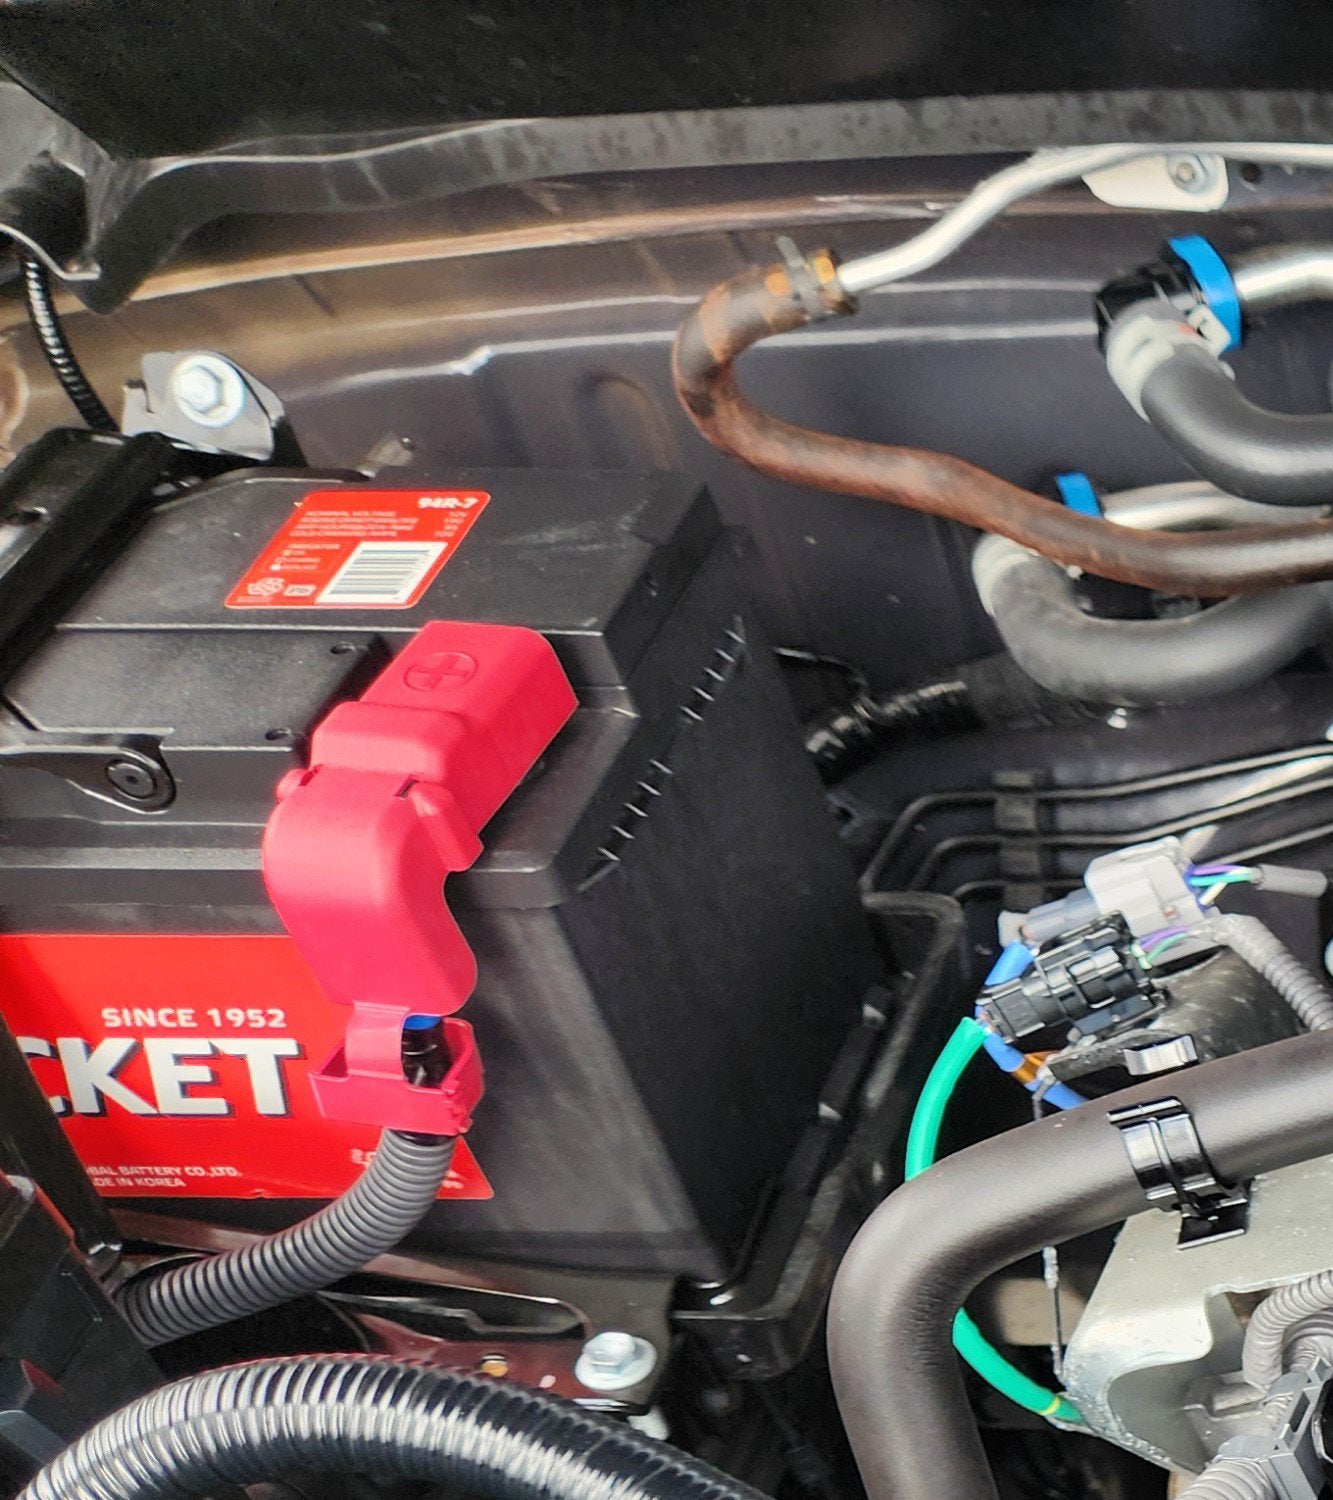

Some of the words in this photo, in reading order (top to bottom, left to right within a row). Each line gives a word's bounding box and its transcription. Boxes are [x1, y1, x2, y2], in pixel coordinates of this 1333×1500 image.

[101, 1007, 198, 1028] SINCE
[207, 1008, 287, 1028] 1952
[118, 1165, 182, 1176] BATTERY
[92, 1177, 116, 1187] DE
[134, 1177, 187, 1188] KOREA
